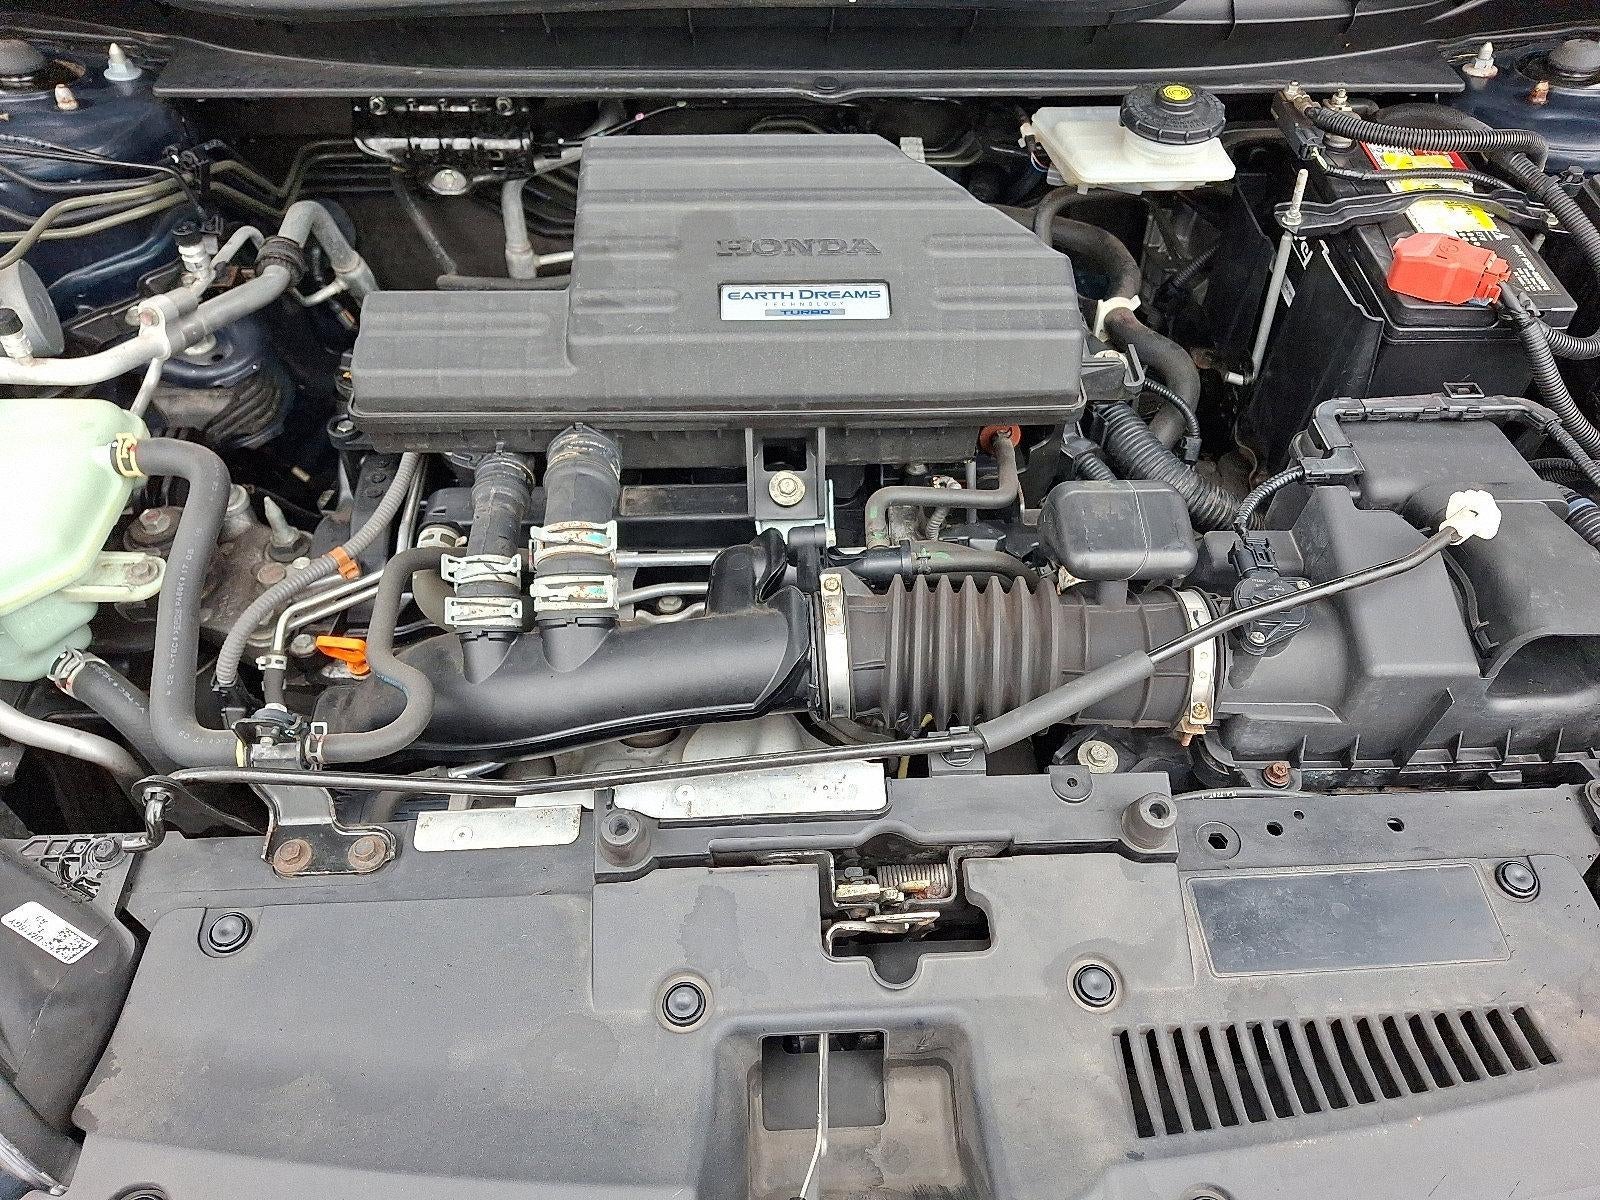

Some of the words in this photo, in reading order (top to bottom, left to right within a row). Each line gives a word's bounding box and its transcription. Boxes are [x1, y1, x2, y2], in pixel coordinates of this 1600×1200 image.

[715, 238, 882, 256] HONDA
[727, 290, 794, 300] EARTH
[798, 289, 882, 300] DREAMS
